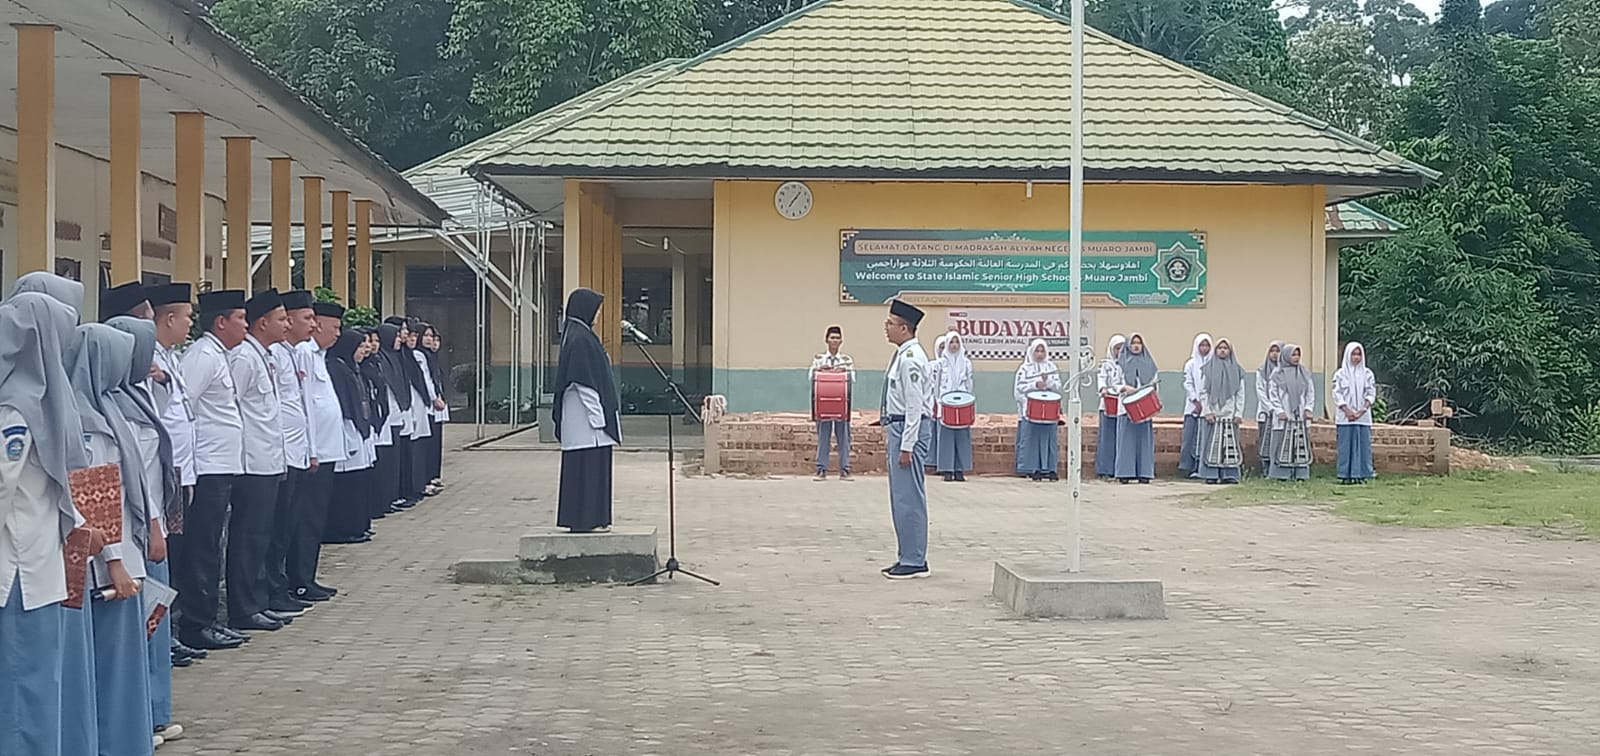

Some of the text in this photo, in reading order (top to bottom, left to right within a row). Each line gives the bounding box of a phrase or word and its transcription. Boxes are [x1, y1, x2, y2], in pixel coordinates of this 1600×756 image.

[857, 244, 900, 252] SELAMAT
[903, 244, 940, 252] DATANG
[943, 244, 953, 252] DI
[955, 244, 1007, 252] MADRASAH
[1010, 245, 1042, 253] ALIYAH
[1044, 245, 1071, 253] NEGE
[855, 271, 1148, 283] Welcome to State Islamic Senior High Schoo Muaro Jambi
